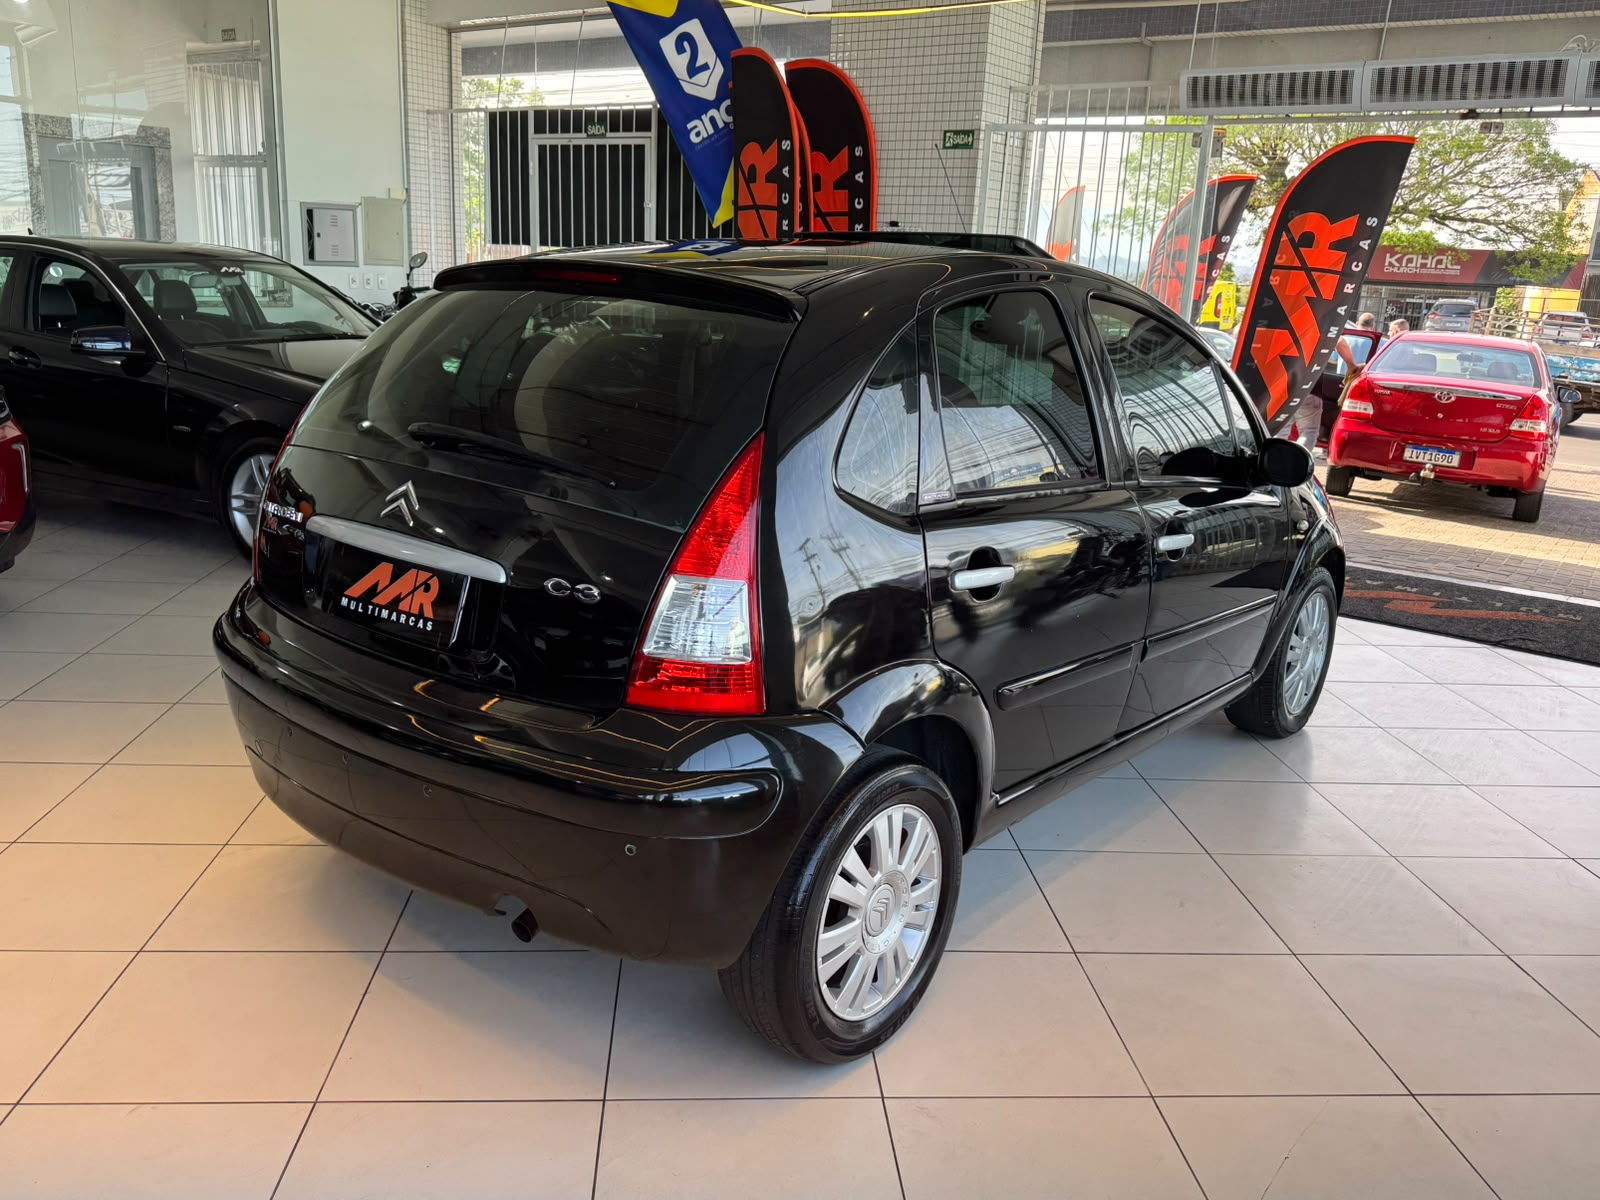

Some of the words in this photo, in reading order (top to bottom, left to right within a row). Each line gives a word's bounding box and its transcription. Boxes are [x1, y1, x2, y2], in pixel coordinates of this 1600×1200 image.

[675, 32, 710, 80] 2
[1384, 266, 1420, 274] CHURCH
[1275, 216, 1378, 423] MULTIMARCAS
[1408, 450, 1454, 464] IVT1G90
[340, 597, 433, 631] MULTIMARCAS
